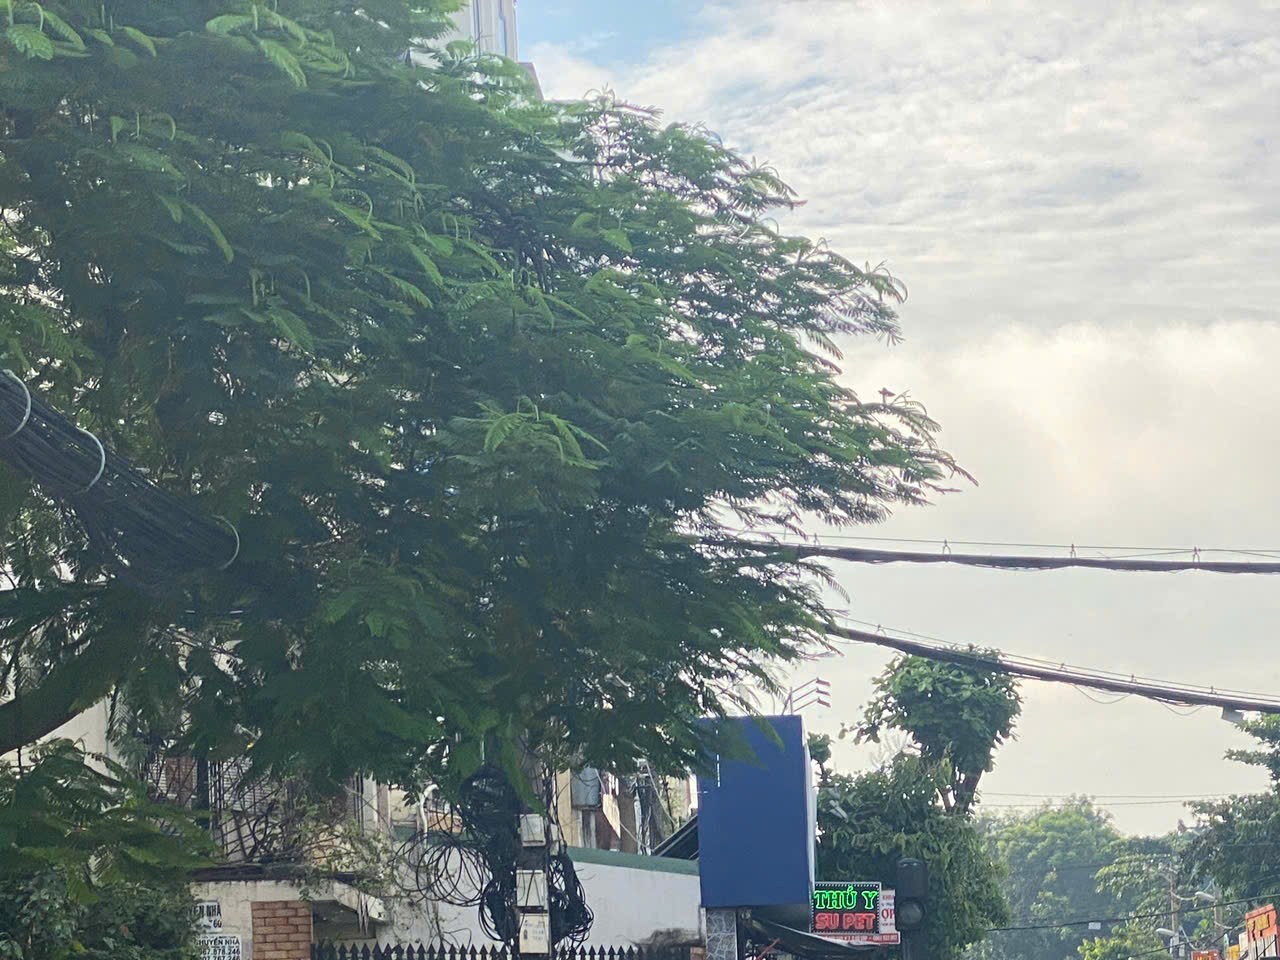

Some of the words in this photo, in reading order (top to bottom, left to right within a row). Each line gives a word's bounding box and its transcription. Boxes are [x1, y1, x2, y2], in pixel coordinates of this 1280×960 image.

[814, 885, 858, 910] THÚ
[861, 890, 878, 910] Y
[815, 913, 840, 931] SU
[843, 913, 876, 931] PET
